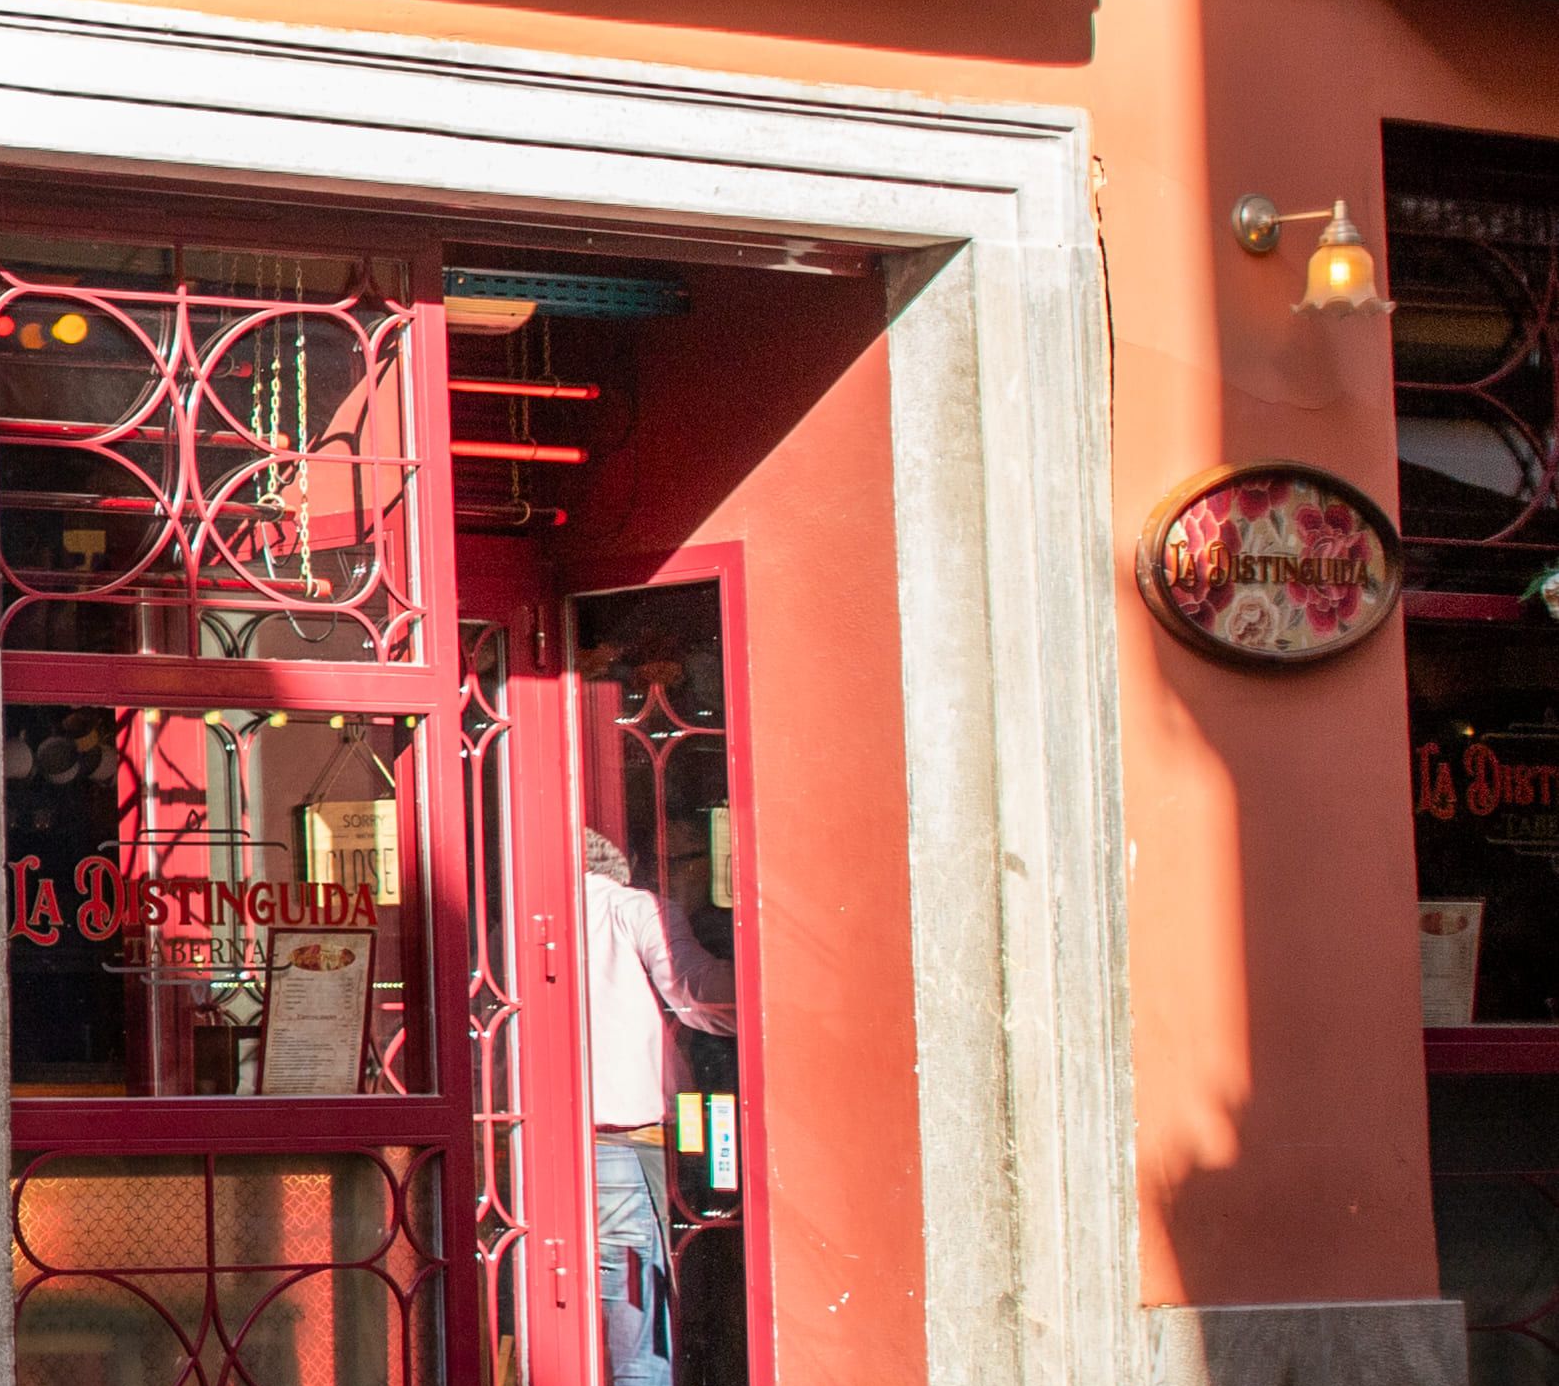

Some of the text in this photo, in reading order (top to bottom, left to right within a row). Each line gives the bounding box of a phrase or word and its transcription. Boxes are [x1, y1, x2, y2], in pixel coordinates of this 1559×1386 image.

[1168, 540, 1198, 589] LA
[1416, 742, 1457, 820] LA
[8, 854, 378, 946] LA DISTINGUIDA
